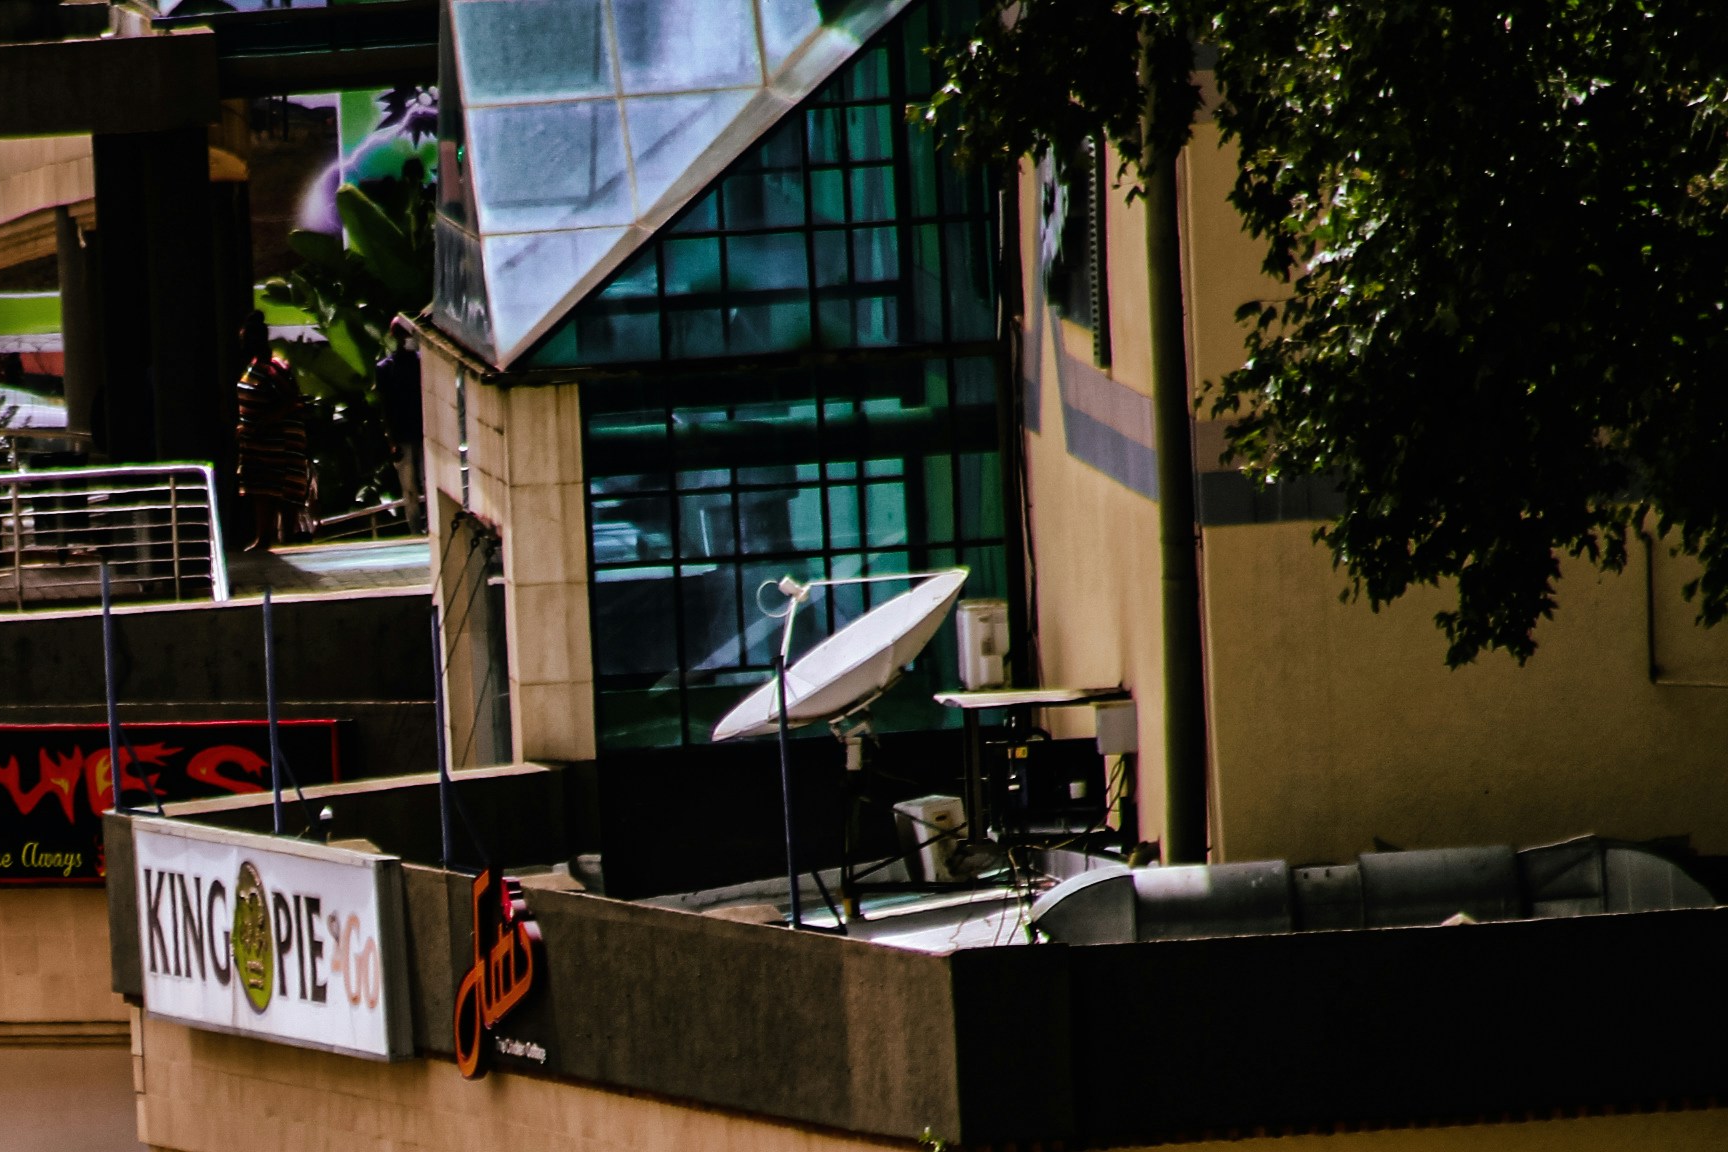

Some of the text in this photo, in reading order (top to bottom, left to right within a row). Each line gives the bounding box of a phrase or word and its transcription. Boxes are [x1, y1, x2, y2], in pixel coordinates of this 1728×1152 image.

[22, 842, 83, 877] Aways
[143, 868, 232, 987] KING
[272, 891, 329, 1004] PIE
